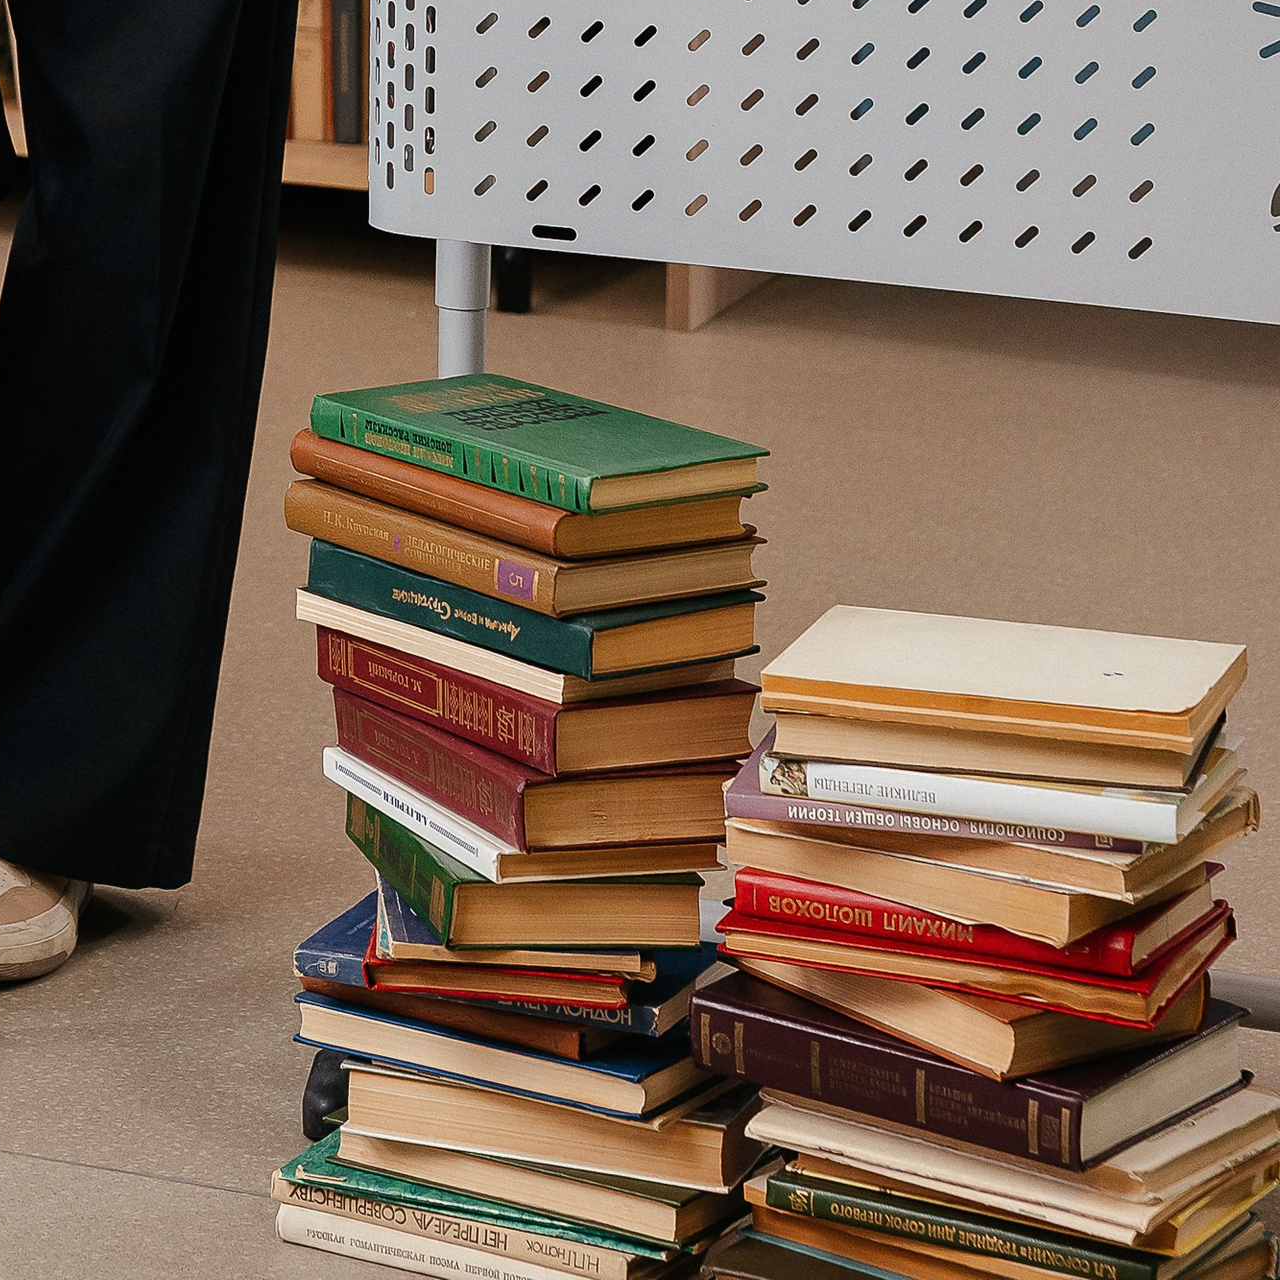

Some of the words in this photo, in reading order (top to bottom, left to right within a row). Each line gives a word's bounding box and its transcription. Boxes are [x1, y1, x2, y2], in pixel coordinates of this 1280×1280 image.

[405, 534, 491, 570] ПЕДАГОГИЧЕСКИЕ
[508, 572, 524, 589] 5
[368, 660, 410, 688] ГОРЬКИЙ
[814, 776, 873, 797] ЛЕГЕНДЫ
[878, 784, 937, 804] ВЕЛИКИЕ
[787, 804, 841, 823] ТЕОРИИ
[844, 810, 895, 829] ОБЩЕЙ
[899, 814, 961, 834] ОСНОВЫ
[964, 819, 1066, 842] СОЦИОЛОГИЯ.
[768, 894, 873, 927] ШОЛОХОВ
[882, 914, 974, 944] МИХАИЛ
[290, 1185, 407, 1226] СОВЕРШЕНСТВУ
[830, 1202, 883, 1226] ПЕРВОГО
[413, 1211, 480, 1244] ПРЕДЕЛА
[885, 1214, 926, 1235] СОРОК
[927, 1222, 957, 1243] ДНИ
[306, 1228, 346, 1245] РУССКАЯ
[349, 1237, 426, 1264] РОМАНТИЧЕСКАЯ
[429, 1255, 460, 1271] ПОЭМА
[482, 1232, 508, 1252] НЕТ
[959, 1230, 1020, 1258] ТРУДНЫЕ
[1027, 1246, 1092, 1274] СОРОКИН
